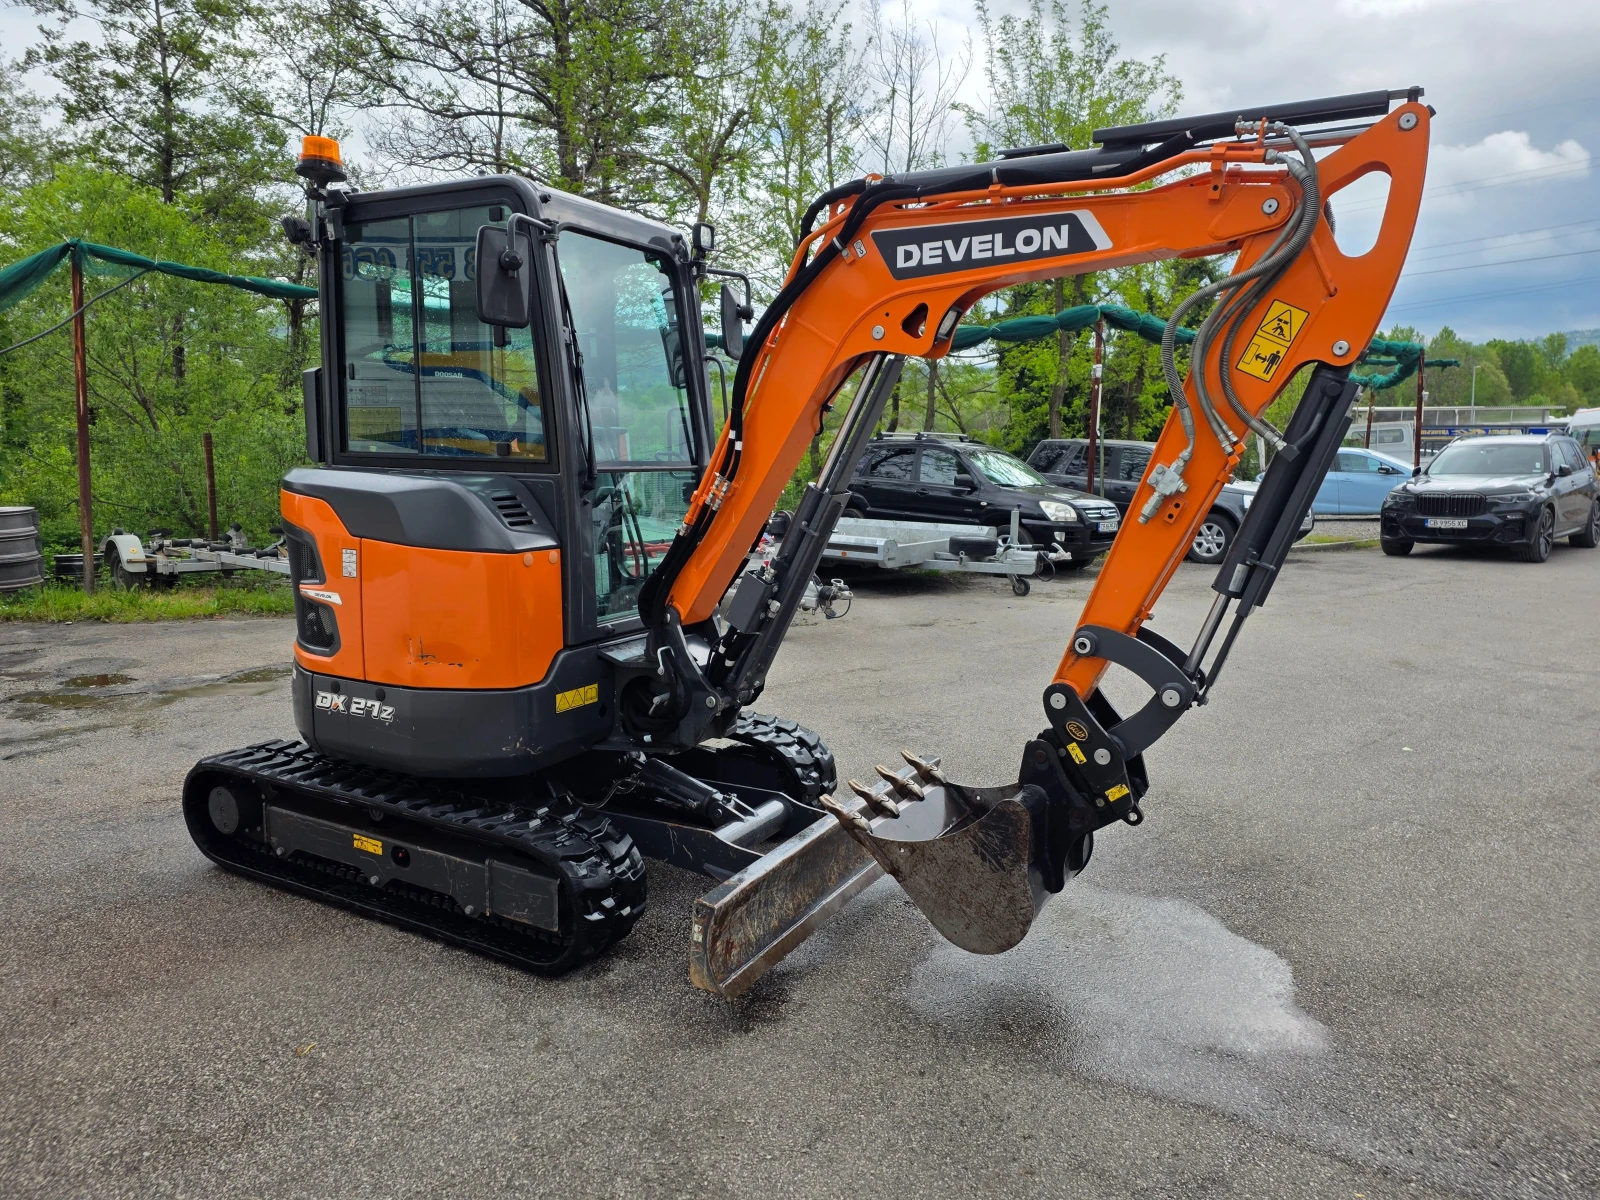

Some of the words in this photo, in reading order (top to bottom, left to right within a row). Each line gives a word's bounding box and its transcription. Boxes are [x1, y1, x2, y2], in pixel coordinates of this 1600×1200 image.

[896, 224, 1069, 269] DEVELON
[434, 371, 463, 379] DOOSAN
[1440, 519, 1456, 527] 9955
[315, 690, 348, 714] DX
